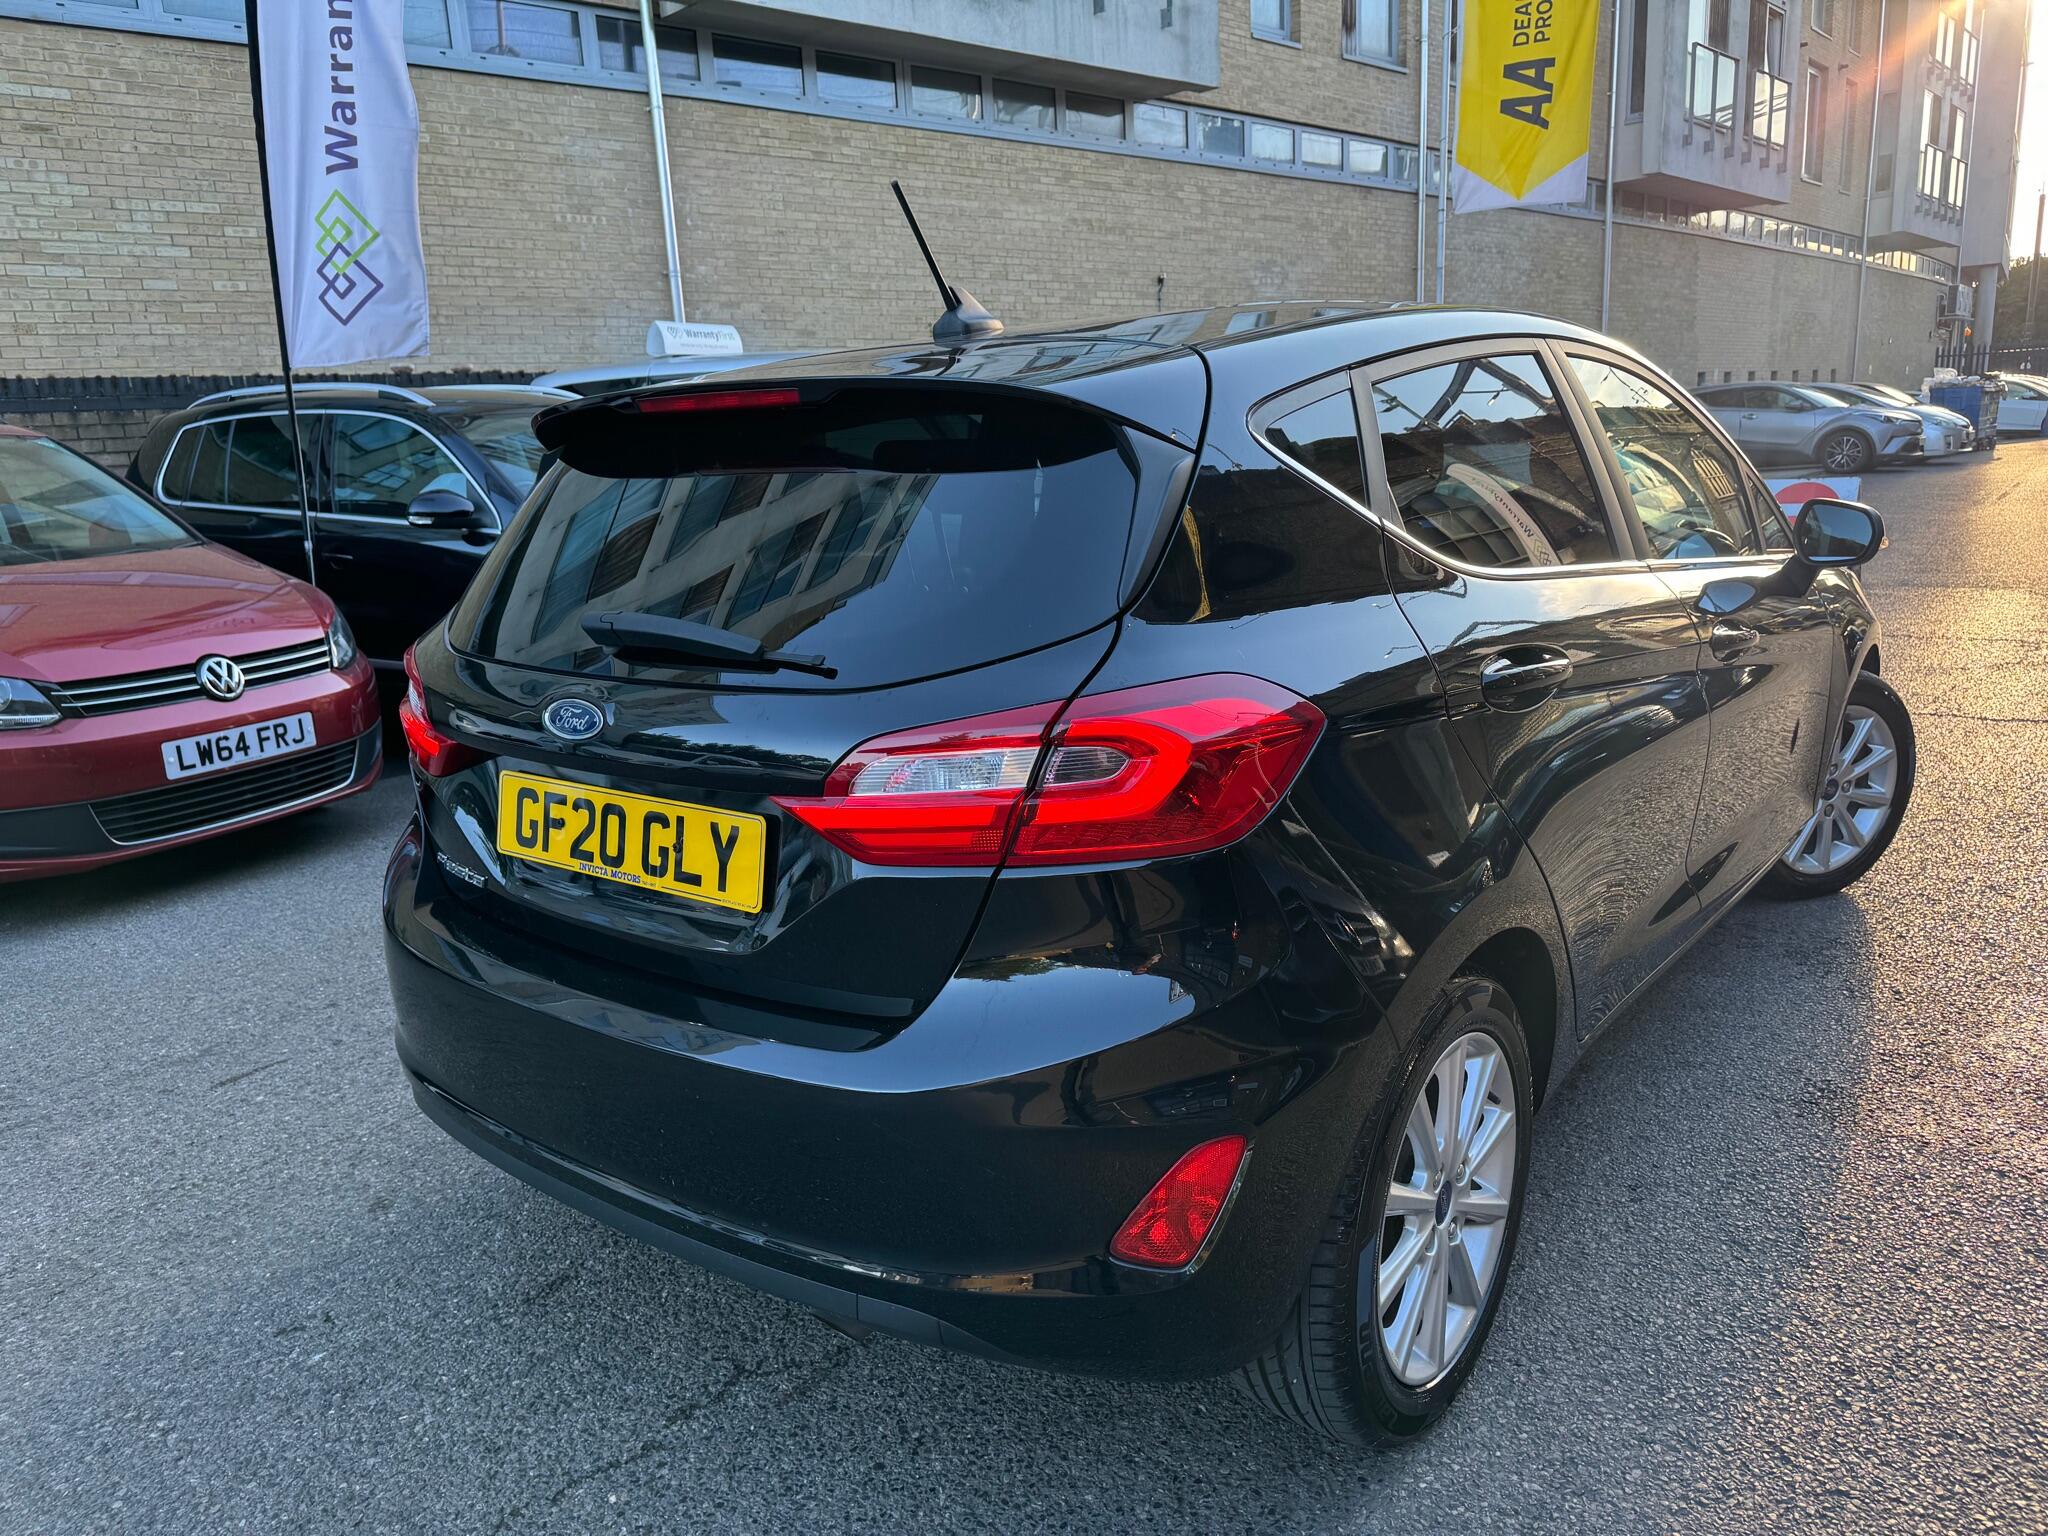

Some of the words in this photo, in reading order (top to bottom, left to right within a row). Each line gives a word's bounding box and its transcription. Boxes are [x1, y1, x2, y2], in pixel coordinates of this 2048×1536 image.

[1512, 0, 1532, 47] DEA
[1500, 57, 1556, 130] AA
[555, 706, 590, 731] Ford
[175, 731, 251, 772] LW64
[256, 718, 306, 753] FRJ
[515, 786, 627, 869] GF20
[641, 810, 740, 893] GLY
[578, 861, 609, 877] INVICTA
[610, 868, 642, 885] MOTORS
